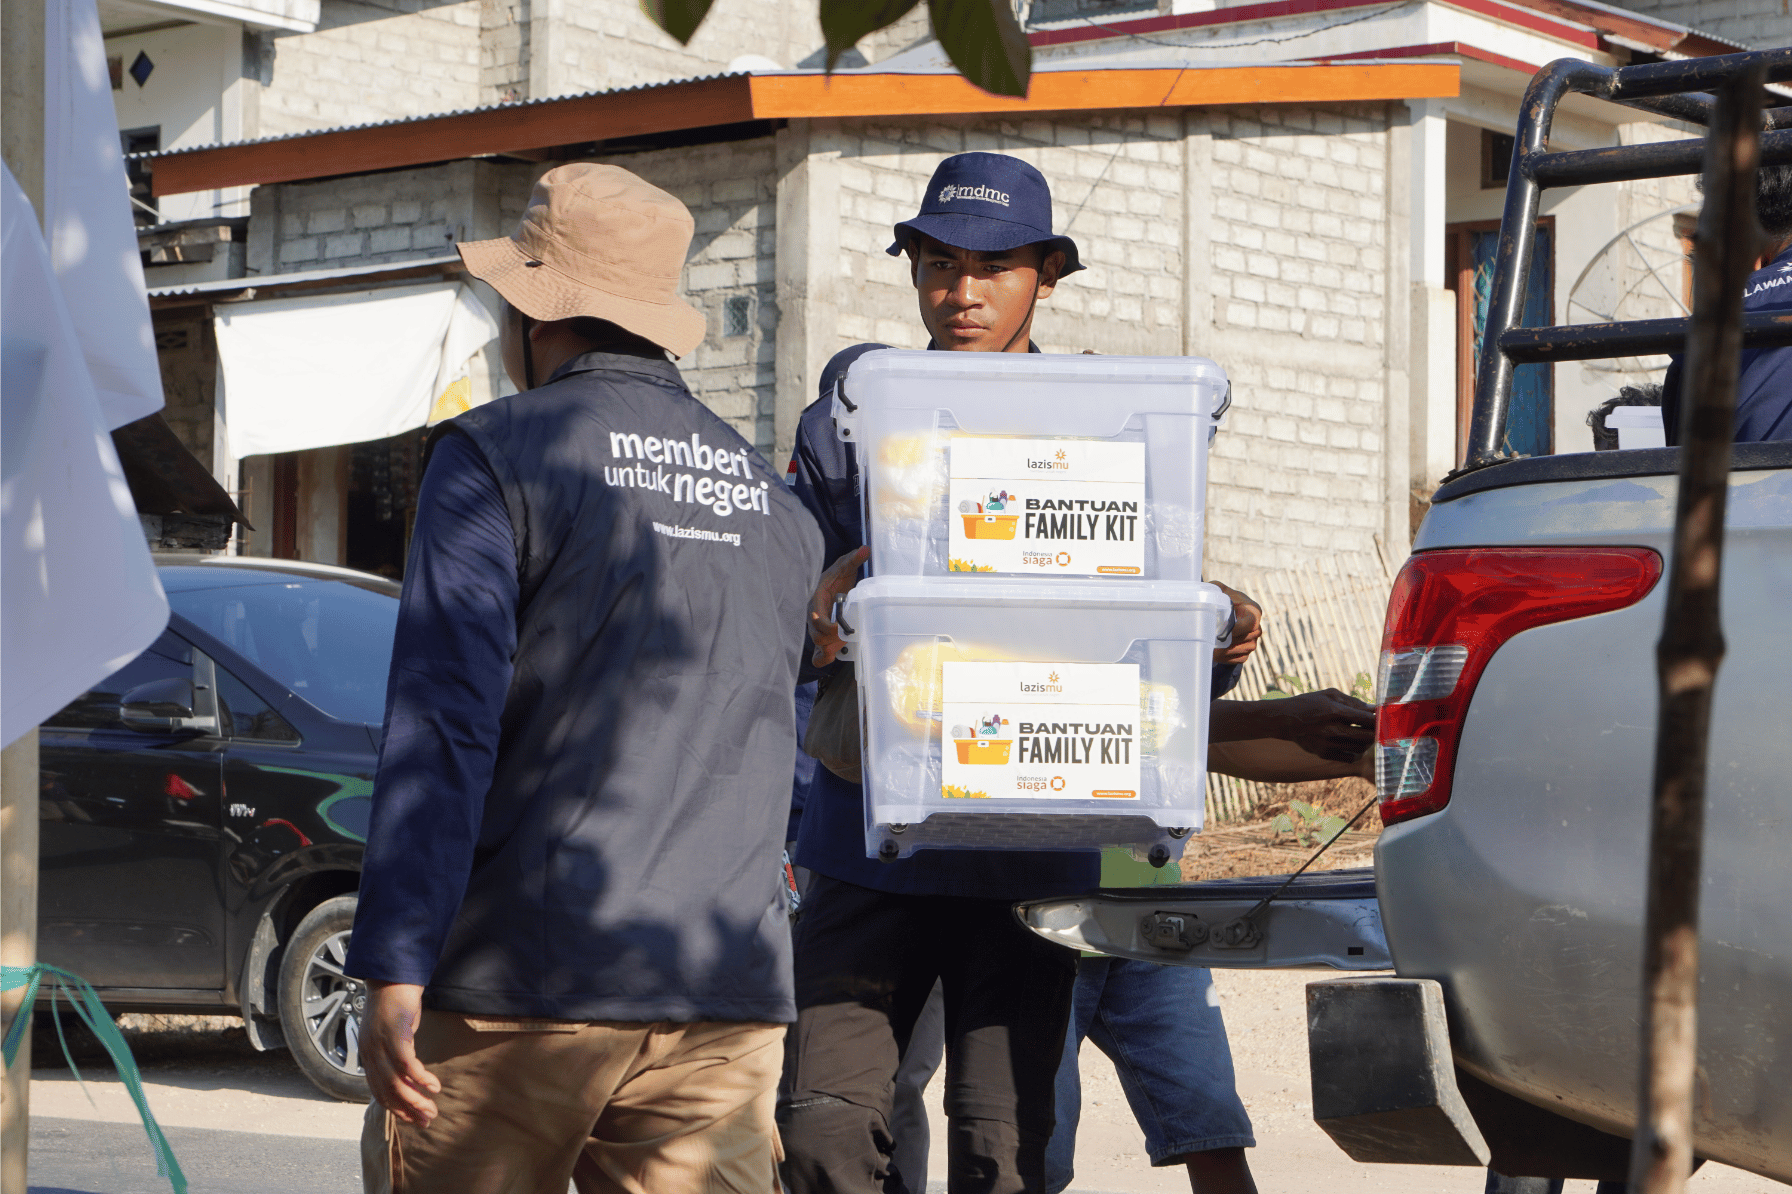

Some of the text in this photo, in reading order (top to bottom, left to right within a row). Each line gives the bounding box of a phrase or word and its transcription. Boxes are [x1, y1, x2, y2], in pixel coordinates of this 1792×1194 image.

[959, 184, 1010, 203] mdmc
[609, 431, 753, 480] memberi
[1027, 458, 1069, 470] lazismu
[604, 462, 771, 517] untuk negeri
[1025, 498, 1138, 513] BANTUAN
[652, 521, 741, 547] www.lazismu.org
[1025, 513, 1138, 542] FAMILY KIT
[1022, 556, 1053, 567] siaga
[1020, 681, 1063, 693] lazismu
[1019, 722, 1133, 736] BANTUAN
[1018, 736, 1133, 765] FAMILY KIT
[1016, 781, 1047, 792] siaga
